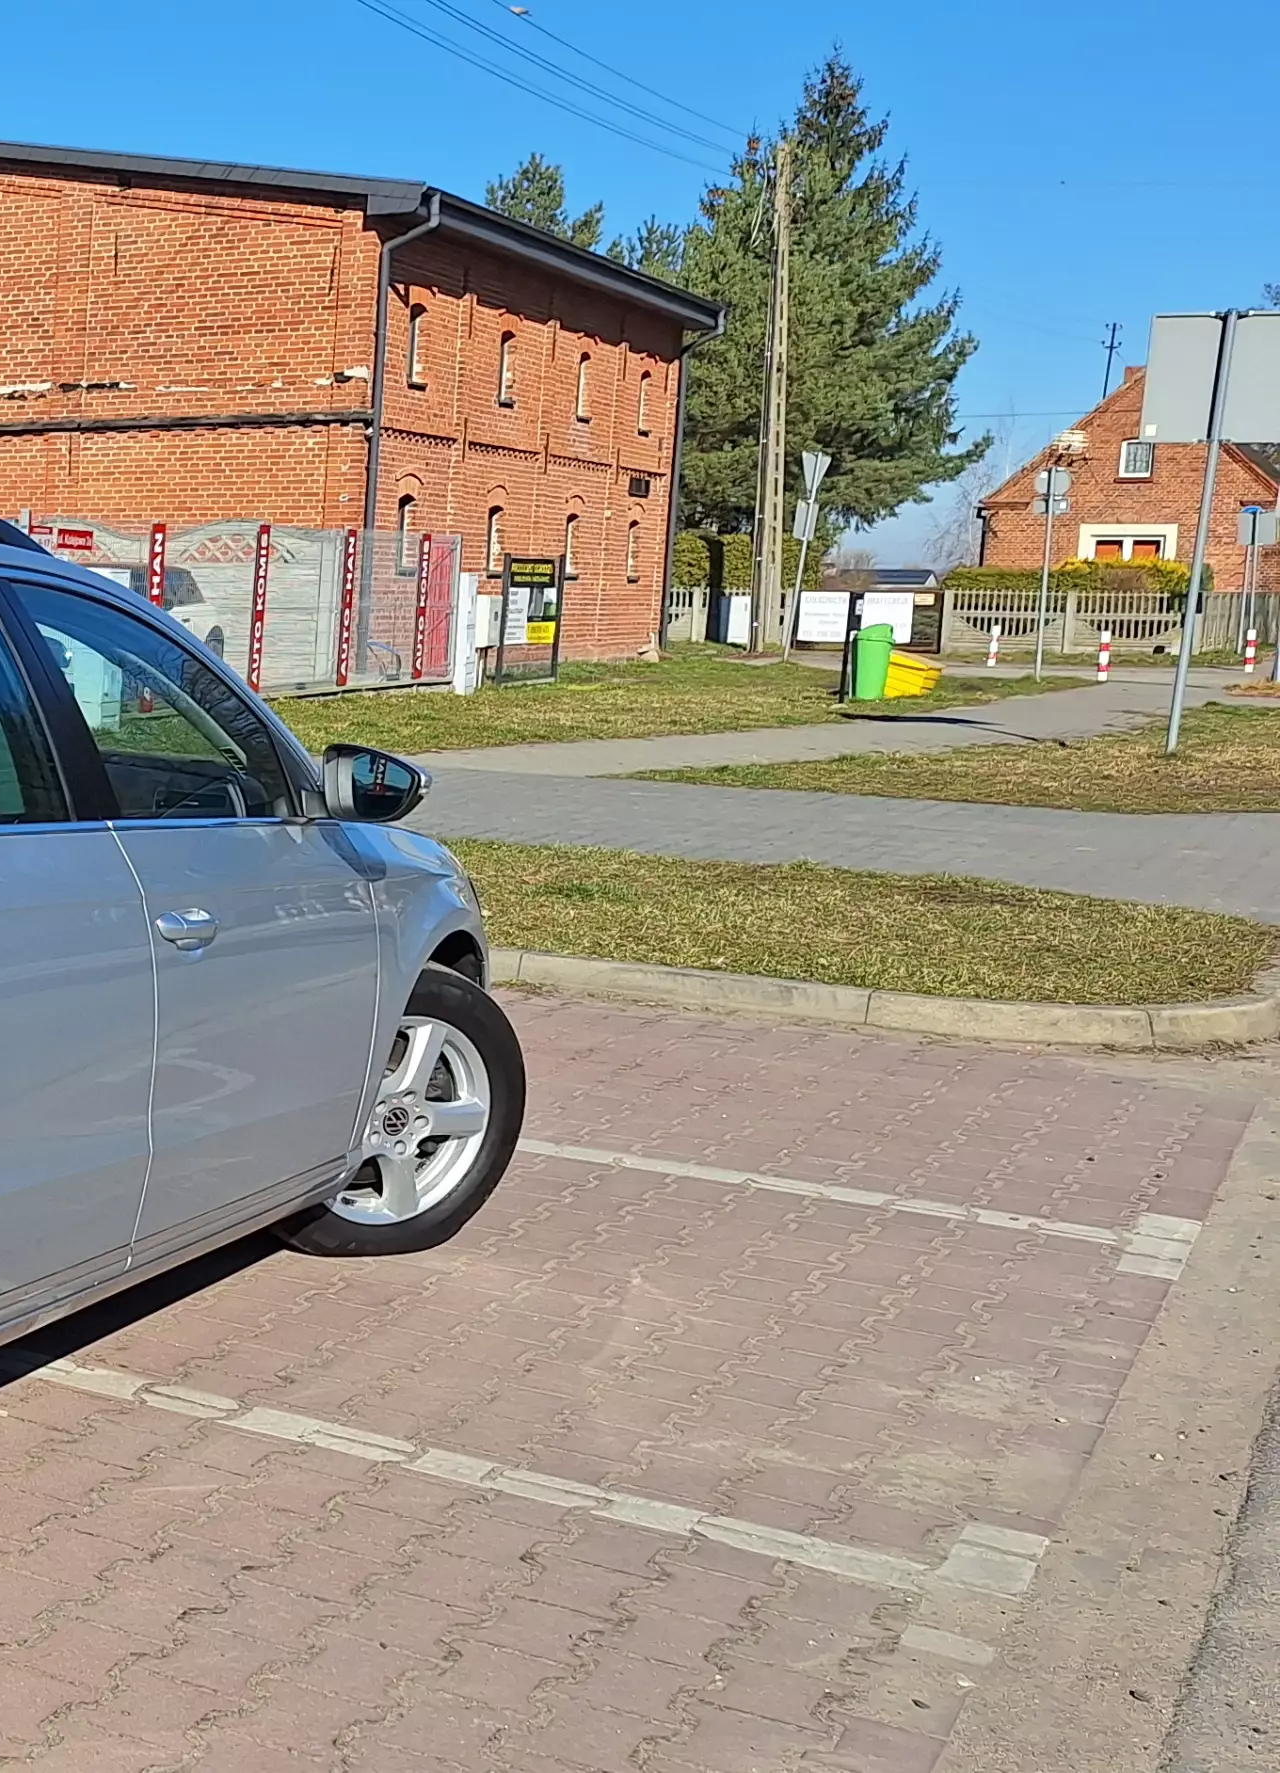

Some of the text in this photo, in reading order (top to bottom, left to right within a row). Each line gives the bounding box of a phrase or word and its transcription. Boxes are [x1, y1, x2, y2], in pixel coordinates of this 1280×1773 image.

[251, 533, 268, 684] AUTO KOMIS
[416, 540, 430, 670] AUTO KOMIS
